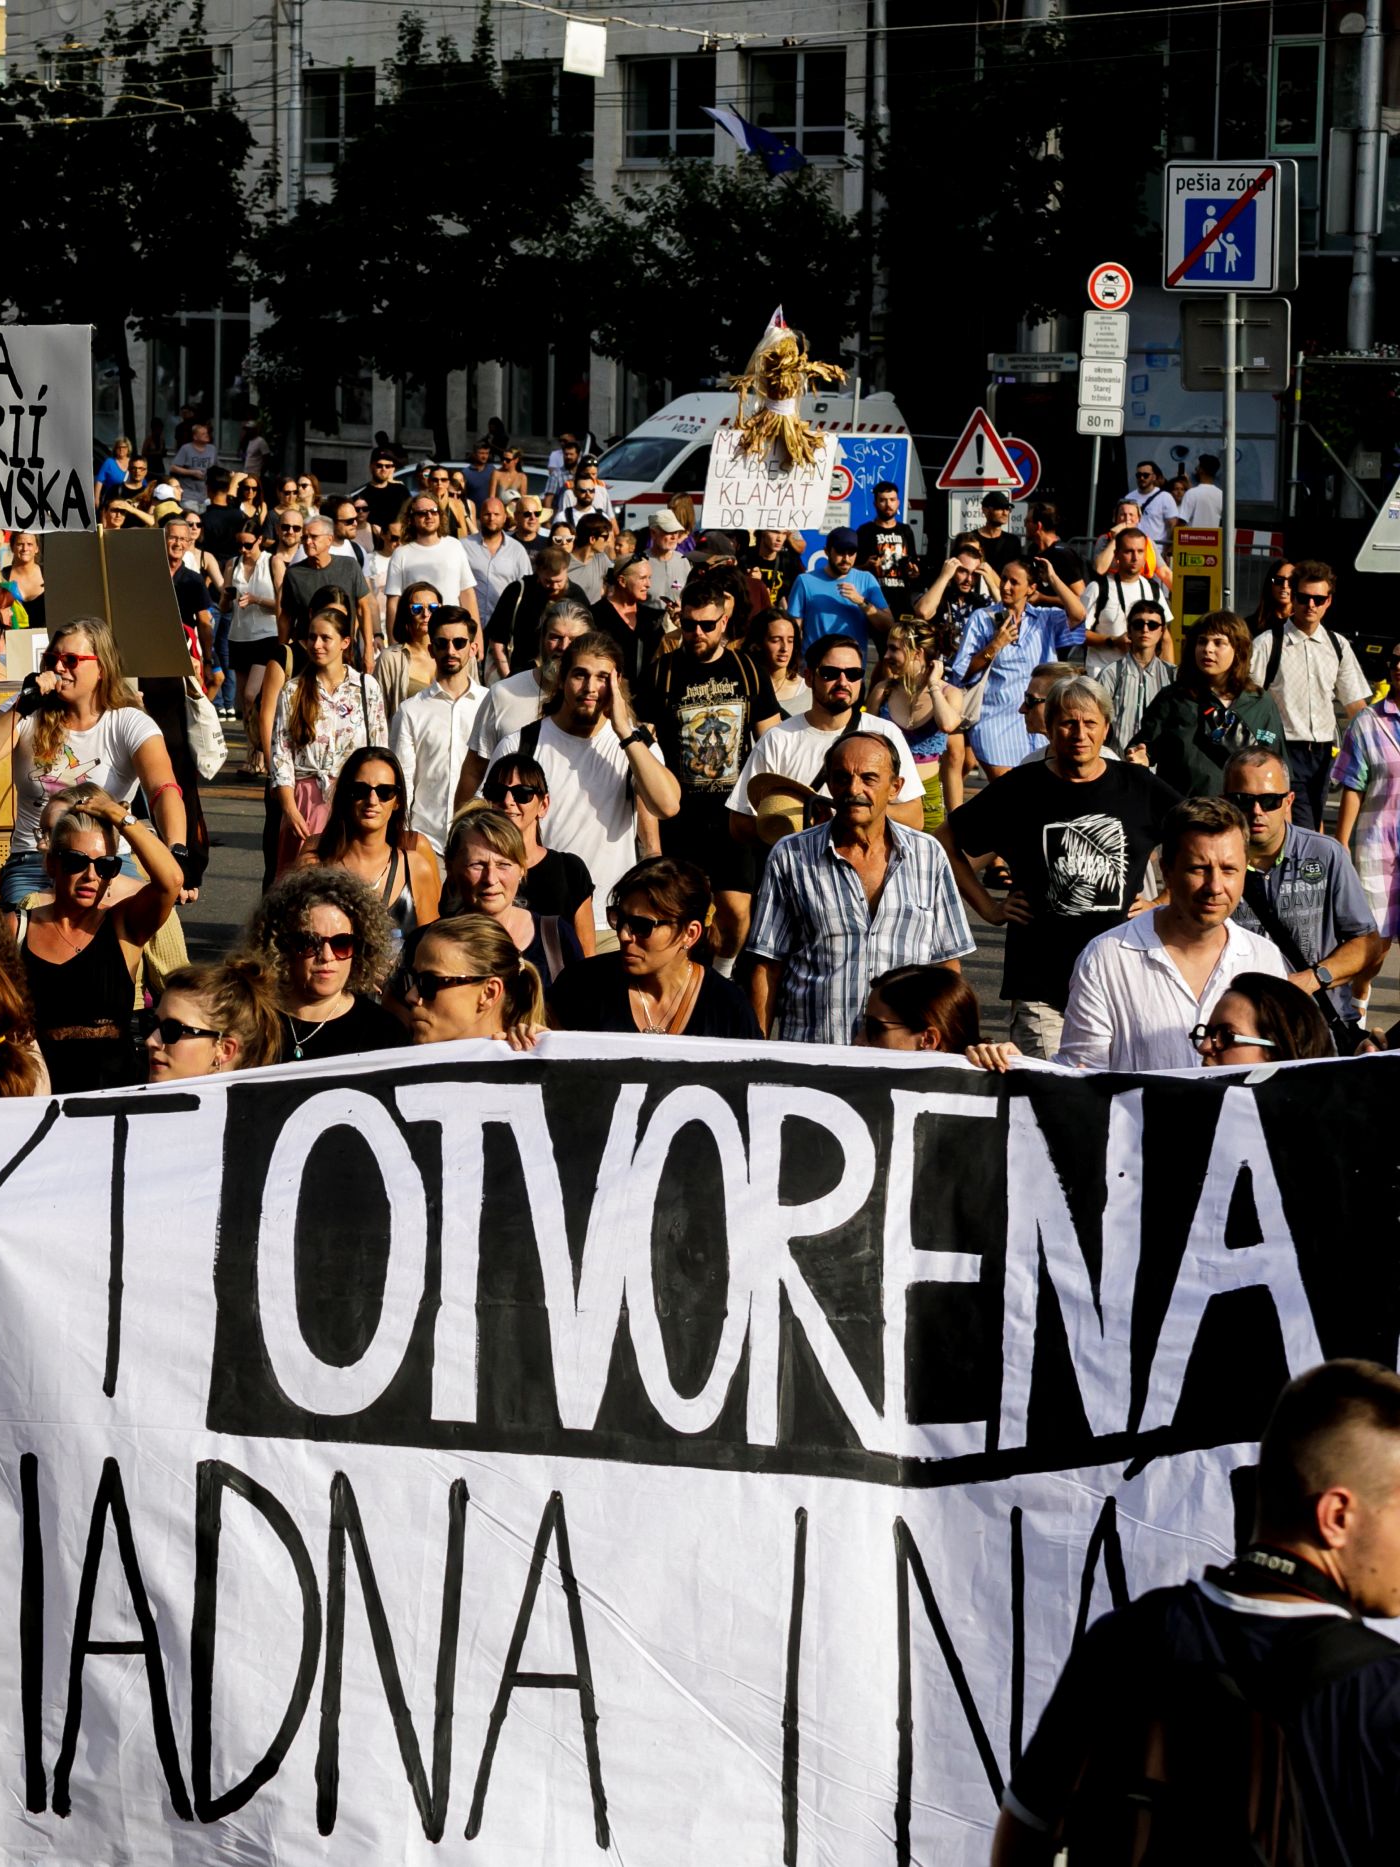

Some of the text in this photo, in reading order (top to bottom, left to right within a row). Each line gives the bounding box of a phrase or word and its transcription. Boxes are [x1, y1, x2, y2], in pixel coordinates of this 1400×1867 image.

[1176, 173, 1266, 195] pešia zóna
[1084, 376, 1121, 384] zásobovania
[1093, 385, 1111, 395] Starej
[1091, 394, 1112, 402] tržnice
[1087, 415, 1114, 428] 80 m
[720, 508, 745, 528] DO
[757, 508, 814, 528] TELKY
